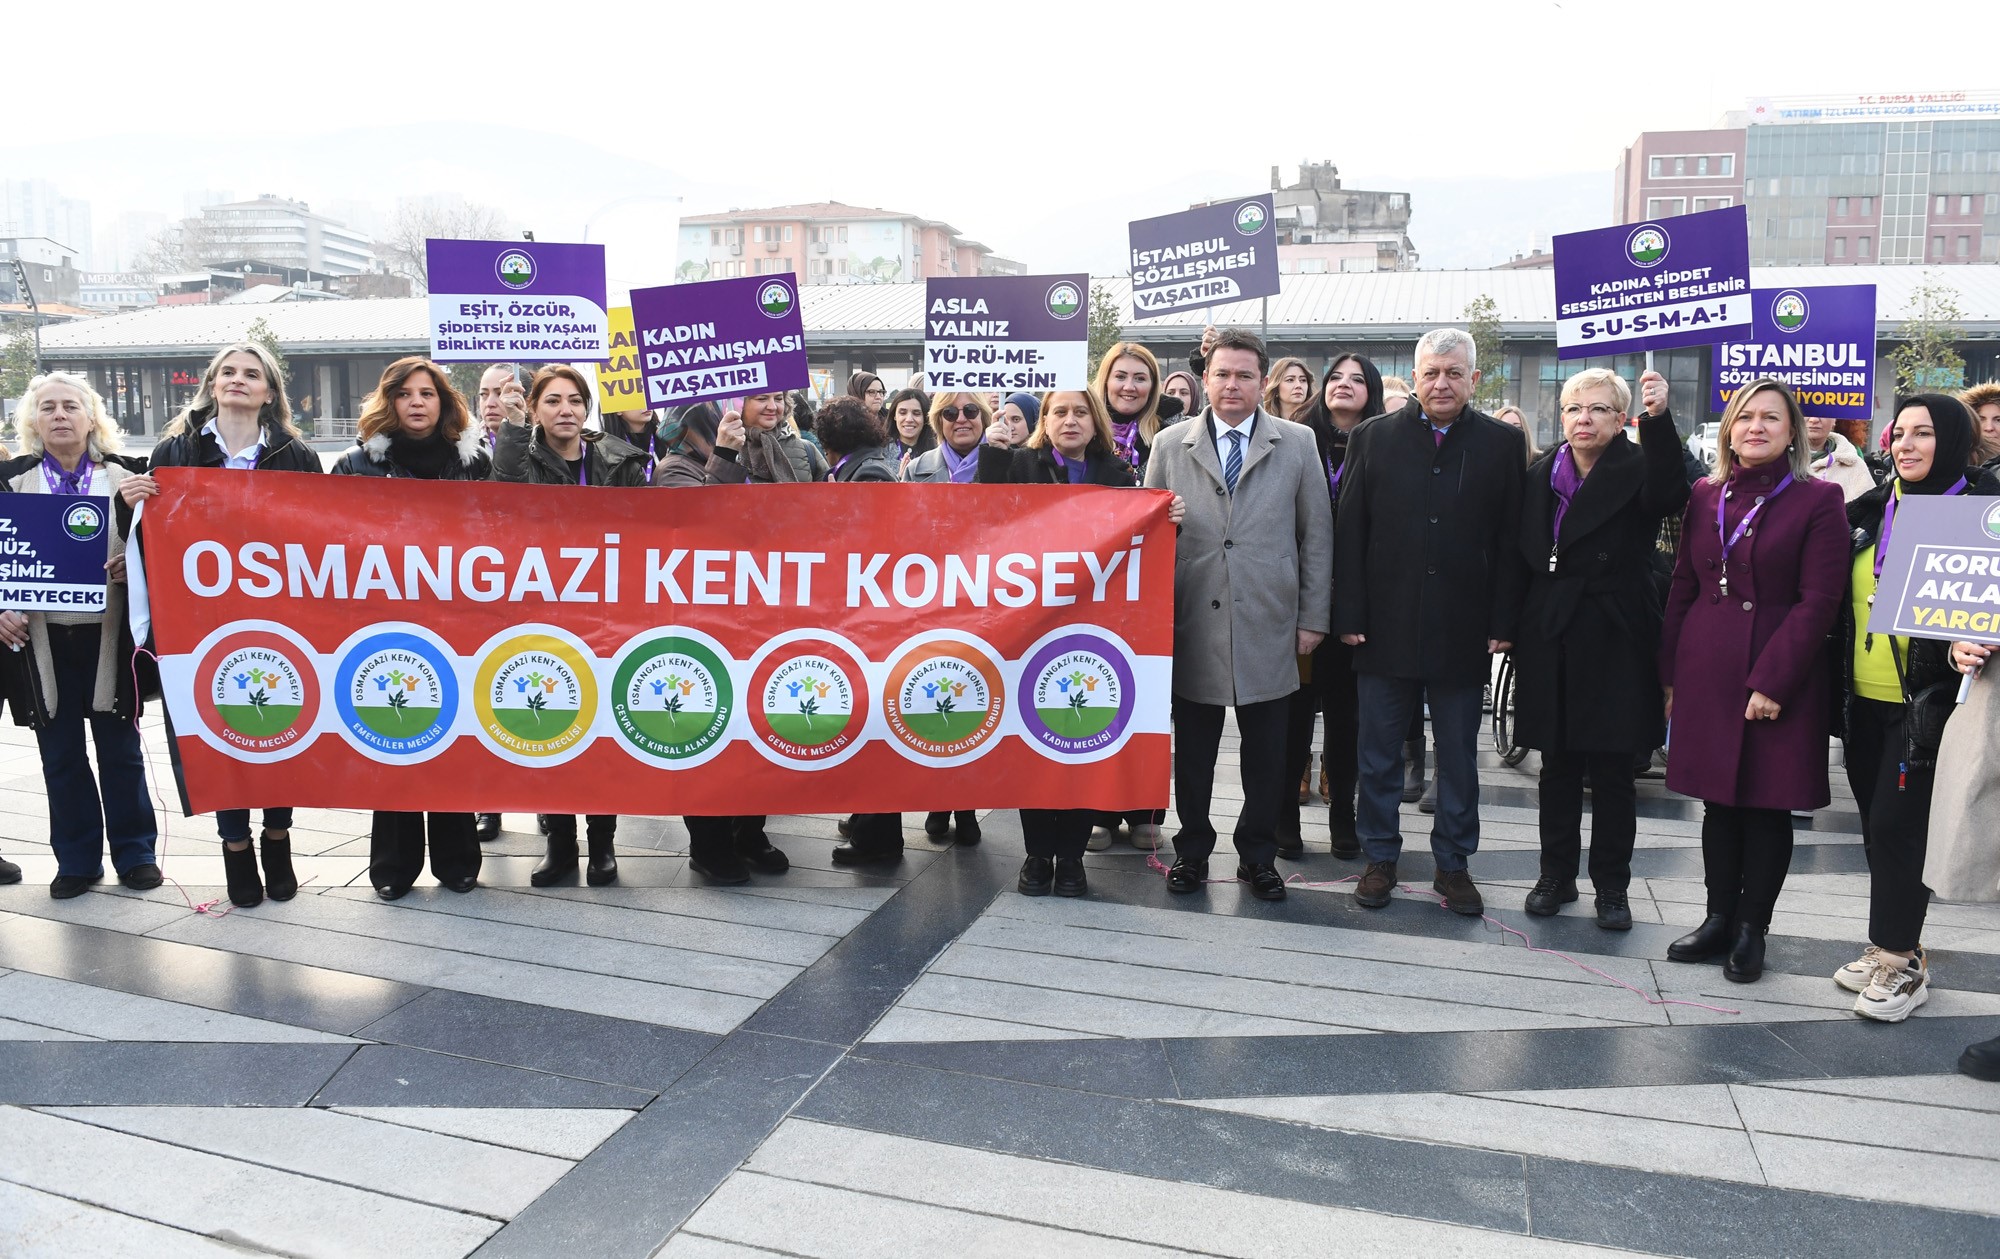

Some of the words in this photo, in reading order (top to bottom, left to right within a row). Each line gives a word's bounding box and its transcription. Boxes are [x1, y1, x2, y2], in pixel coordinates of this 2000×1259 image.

[1133, 237, 1230, 267] İSTANBUL
[1133, 246, 1256, 286] SÖZLEŞMESİ
[88, 274, 132, 284] MEDICA
[1140, 280, 1230, 306] YAŞATIR!
[1591, 277, 1651, 295] KADINA
[1654, 267, 1712, 288] ŞİDDET
[930, 298, 989, 315] ASLA
[1562, 290, 1664, 315] SESSİZLİKTEN
[1668, 276, 1745, 300] BESLENİR
[460, 300, 503, 320] EŞİT,
[508, 301, 576, 319] ÖZGÜR,
[1581, 304, 1728, 339] S-U-S-M-A-!
[439, 321, 513, 335] ŞİDDETSİZ
[517, 321, 540, 333] BİR
[544, 324, 597, 336] YAŞAMI
[642, 322, 716, 347] KADIN
[930, 320, 1009, 337] YALNIZ
[438, 337, 505, 350] BİRLİKTE
[510, 338, 600, 350] KURACAĞIZ!
[646, 334, 803, 370] DAYANIŞMASI
[929, 344, 1045, 364] YÜ-RÜ-ME-
[1721, 342, 1866, 367] İSTANBUL
[655, 367, 759, 396] YAŞATIR!
[928, 368, 1057, 388] YE-CEK-SİN!
[0, 537, 37, 558] ÜZ,
[182, 533, 620, 603] OSMANGAZİ
[645, 548, 825, 606] KENT
[846, 535, 1144, 608] KONSEYİ
[217, 652, 248, 699] OSMANGAZİ
[251, 652, 277, 663] KENT
[278, 661, 301, 701] KONSEYİ
[356, 653, 388, 700] OSMANGAZİ
[391, 654, 417, 665] KENT
[418, 663, 440, 703] KONSEYİ
[495, 655, 528, 703] OSMANGAZİ
[531, 656, 556, 667] KENT
[556, 665, 578, 705] KONSEYİ
[632, 658, 666, 705] OSMANGAZİ
[669, 658, 693, 669] KENT
[693, 667, 714, 708] KONSEYİ
[768, 660, 802, 708] OSMANGAZİ
[805, 660, 829, 671] KENT
[829, 669, 850, 710] KONSEYİ
[904, 661, 938, 709] OSMANGAZİ
[941, 662, 966, 672] KENT
[966, 670, 986, 707] KONSEYİ
[1038, 656, 1071, 703] OSMANGAZİ
[1074, 656, 1098, 666] KENT
[1098, 664, 1118, 703] KONSEYİ
[223, 729, 255, 747] ÇOCUK
[259, 728, 298, 748] MECLİSİ
[353, 723, 404, 749] EMEKLİLER
[407, 723, 443, 749] MECLİSİ
[489, 724, 544, 752] ENGELLİLER
[547, 724, 583, 751] MECLİSİ
[615, 704, 636, 734] ÇEVRE
[634, 732, 647, 744] VE
[647, 741, 682, 754] KIRSAL
[684, 737, 709, 753] ALAN
[707, 706, 728, 738] GRUBU
[887, 699, 907, 735] HAYVAN
[905, 734, 945, 753] HAKLARI
[948, 729, 988, 753] ÇALIŞMA
[985, 696, 1002, 728] GRUBU
[768, 734, 807, 756] GENÇLİK
[810, 734, 849, 756] MECLİSİ
[1043, 732, 1070, 749] KADIN
[1074, 730, 1112, 749] MECLİSİ
